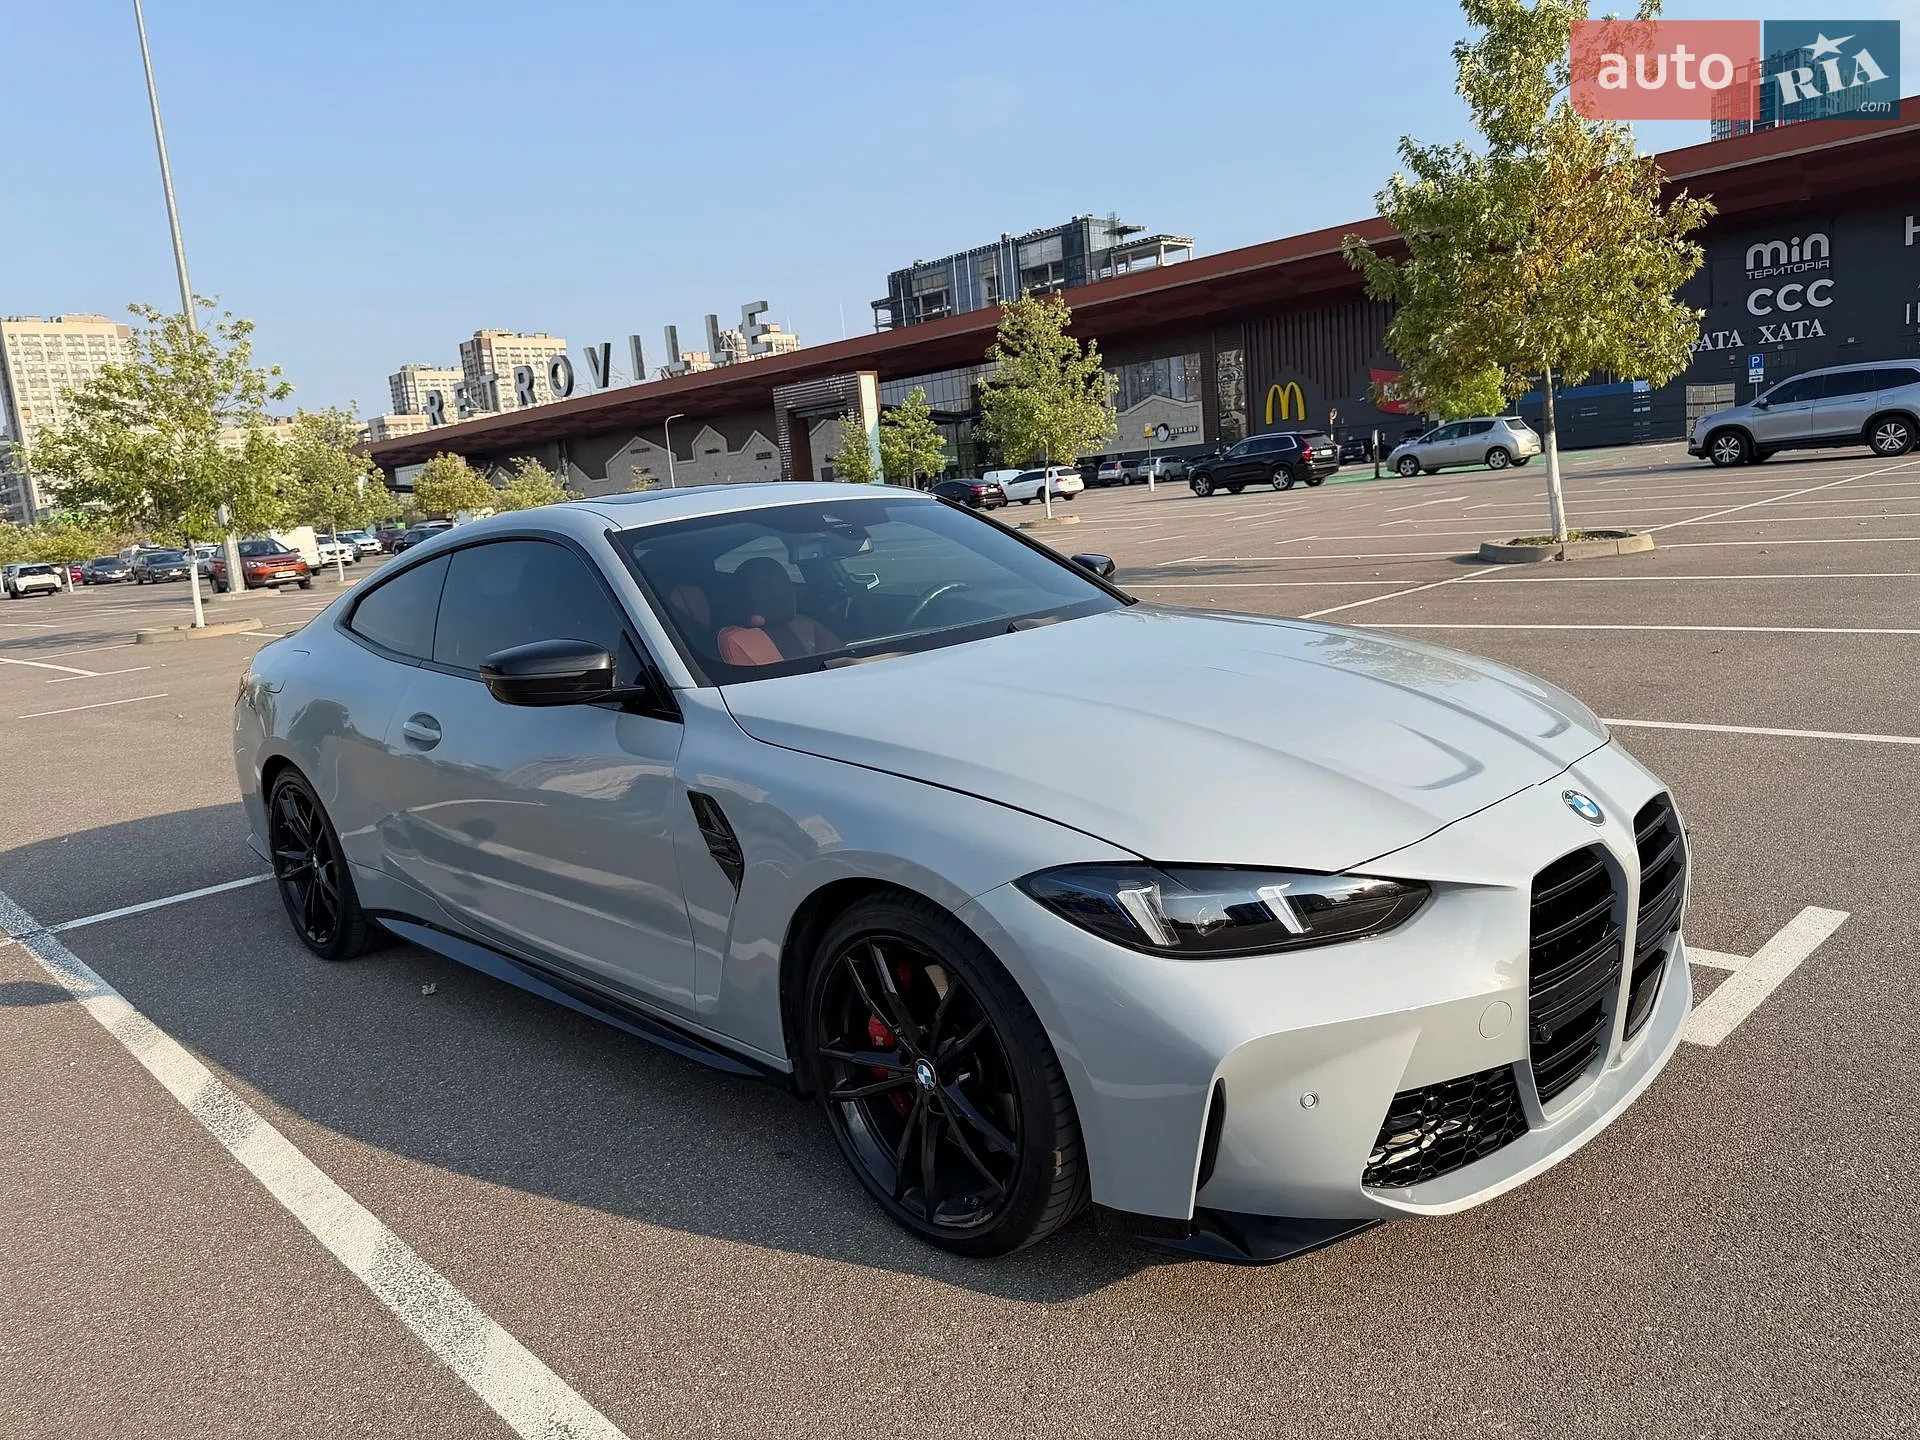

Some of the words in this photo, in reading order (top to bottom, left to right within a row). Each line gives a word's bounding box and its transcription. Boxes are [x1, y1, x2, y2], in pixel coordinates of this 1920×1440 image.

[1746, 259, 1830, 280] ТЕРИТОРІЯ
[1746, 278, 1835, 316] CCC
[1758, 318, 1826, 344] ХАТА
[426, 300, 773, 426] RETROVILLE
